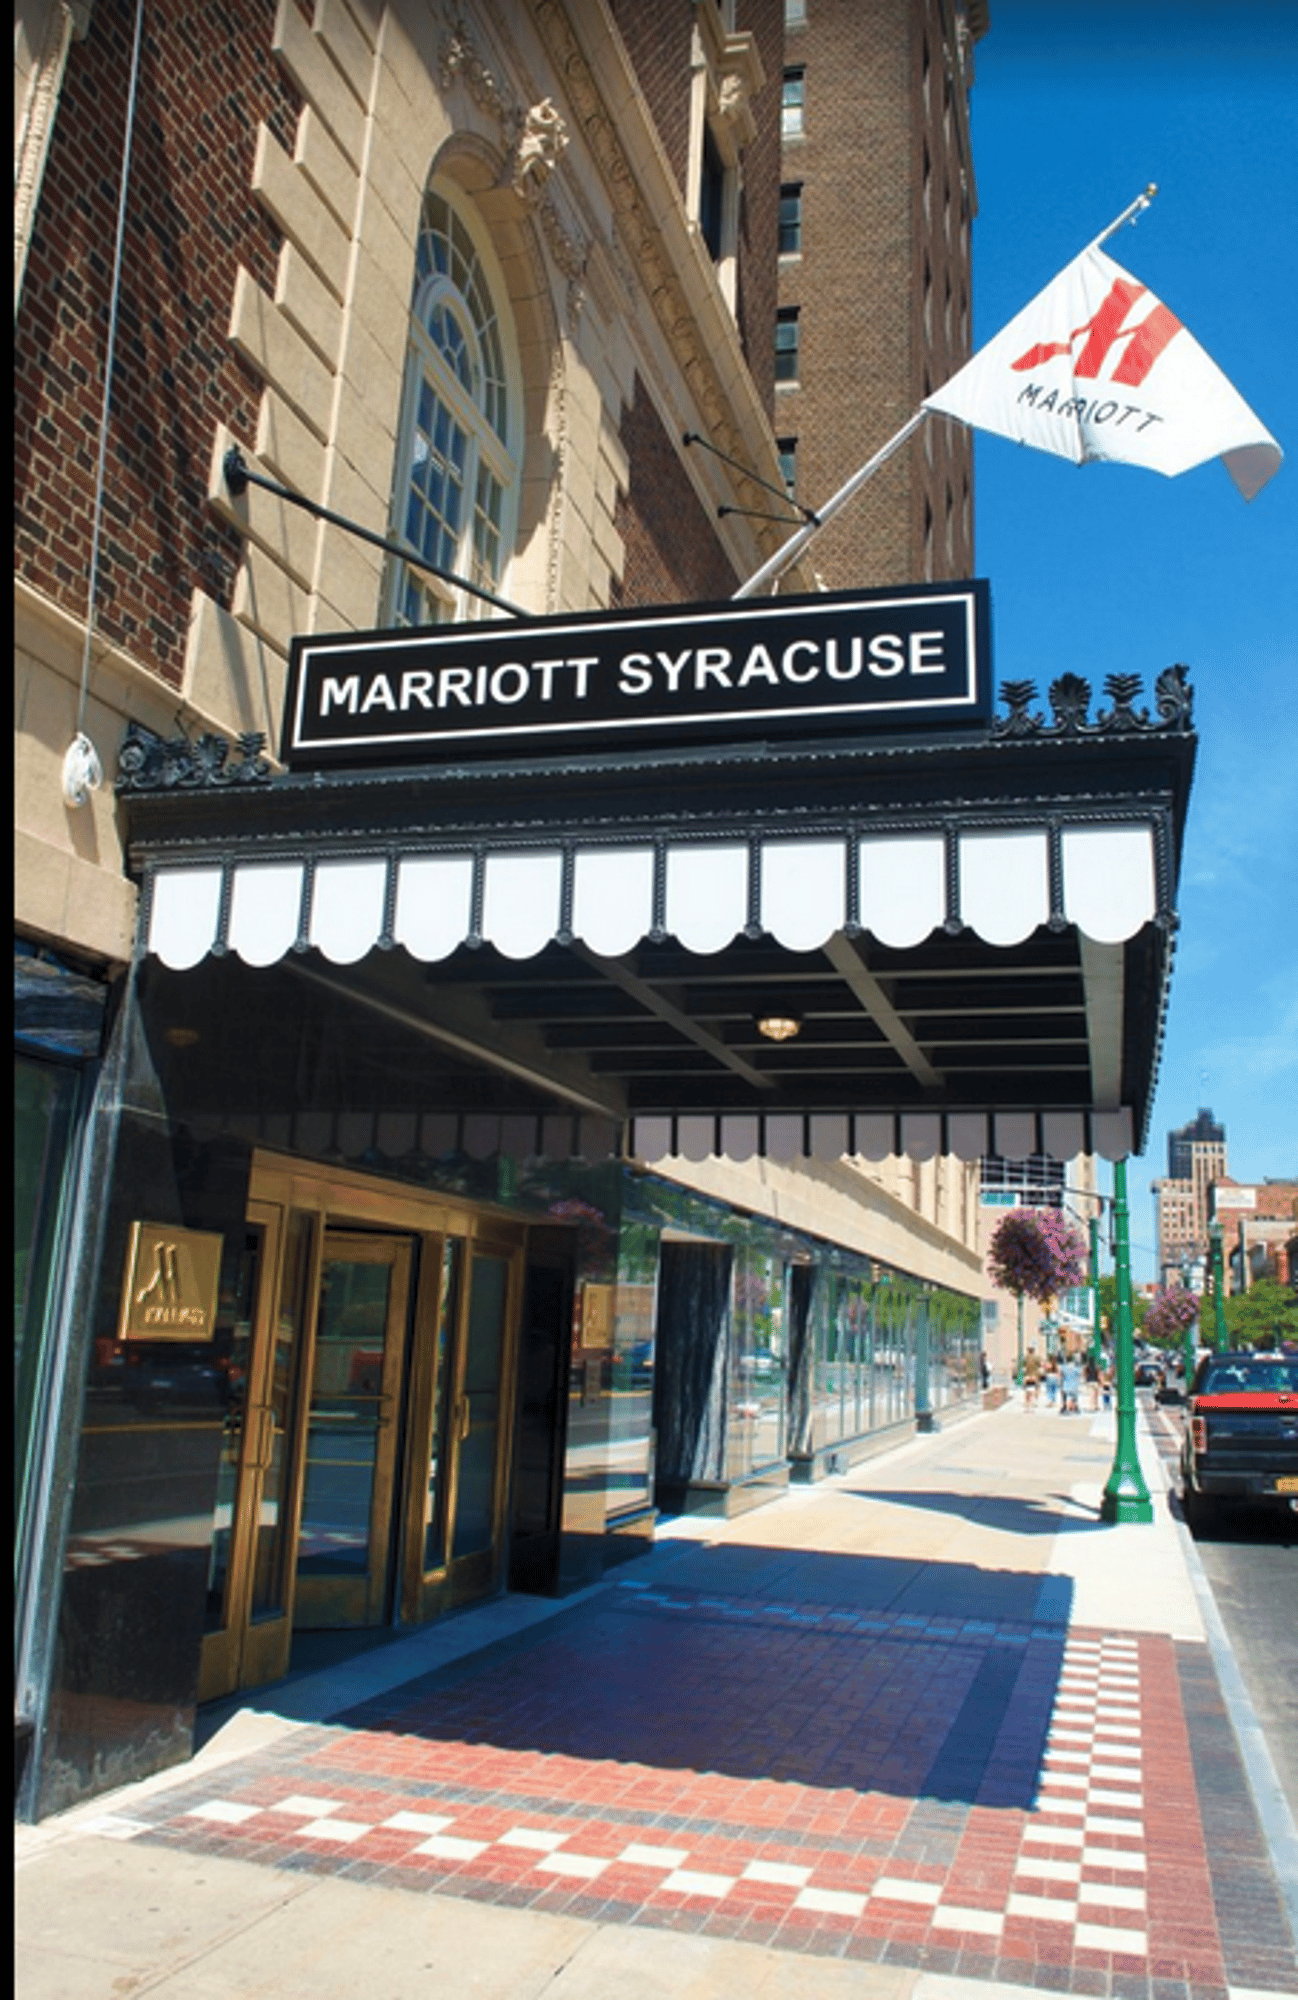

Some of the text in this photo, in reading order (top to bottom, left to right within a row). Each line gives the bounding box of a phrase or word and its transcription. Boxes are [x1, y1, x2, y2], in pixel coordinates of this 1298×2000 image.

[1017, 382, 1164, 433] MARRIOTT
[319, 631, 946, 717] MARRIOTT SYRACUSE
